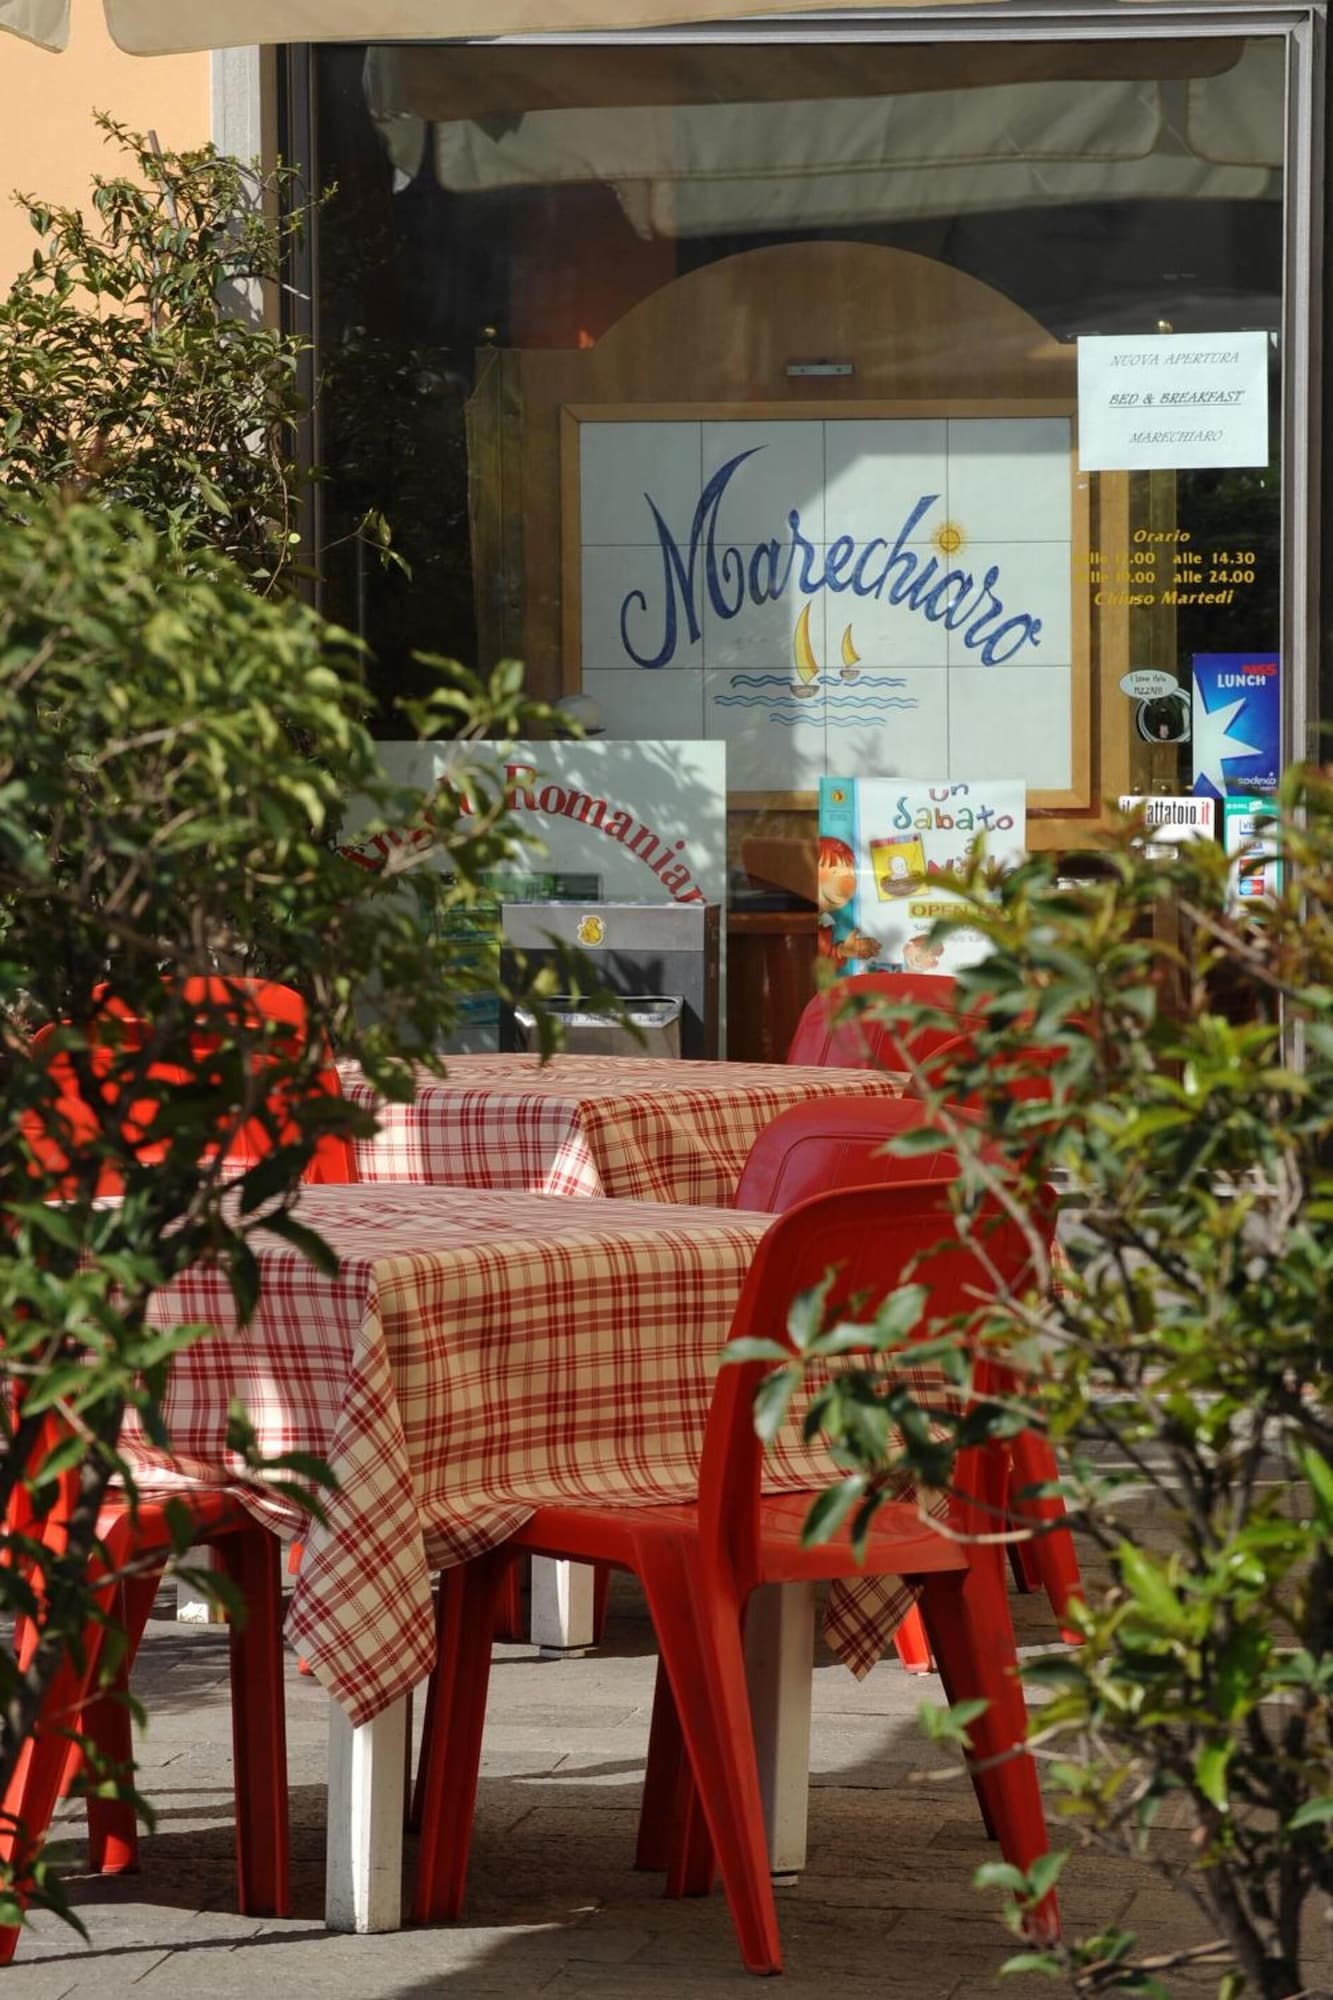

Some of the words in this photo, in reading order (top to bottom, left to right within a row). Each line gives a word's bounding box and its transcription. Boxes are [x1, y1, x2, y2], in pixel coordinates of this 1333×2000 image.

[1110, 352, 1159, 367] NUOVA
[1165, 351, 1239, 365] APERTURA
[1109, 393, 1139, 406] BED
[1143, 393, 1153, 405] &
[1160, 390, 1245, 405] BREAKFAST
[1130, 430, 1223, 444] MARECHIARO
[1133, 529, 1191, 543] Orario
[621, 444, 1042, 669] Marechiaro
[1172, 551, 1202, 565] alle
[1212, 551, 1256, 565] 14.30
[1173, 570, 1202, 584] alle
[1209, 570, 1256, 584] 24.00
[1094, 591, 1155, 606] Chiuso
[1217, 673, 1266, 688] LUNCH
[893, 796, 1014, 831] Sabato
[911, 903, 968, 917] OPEN
